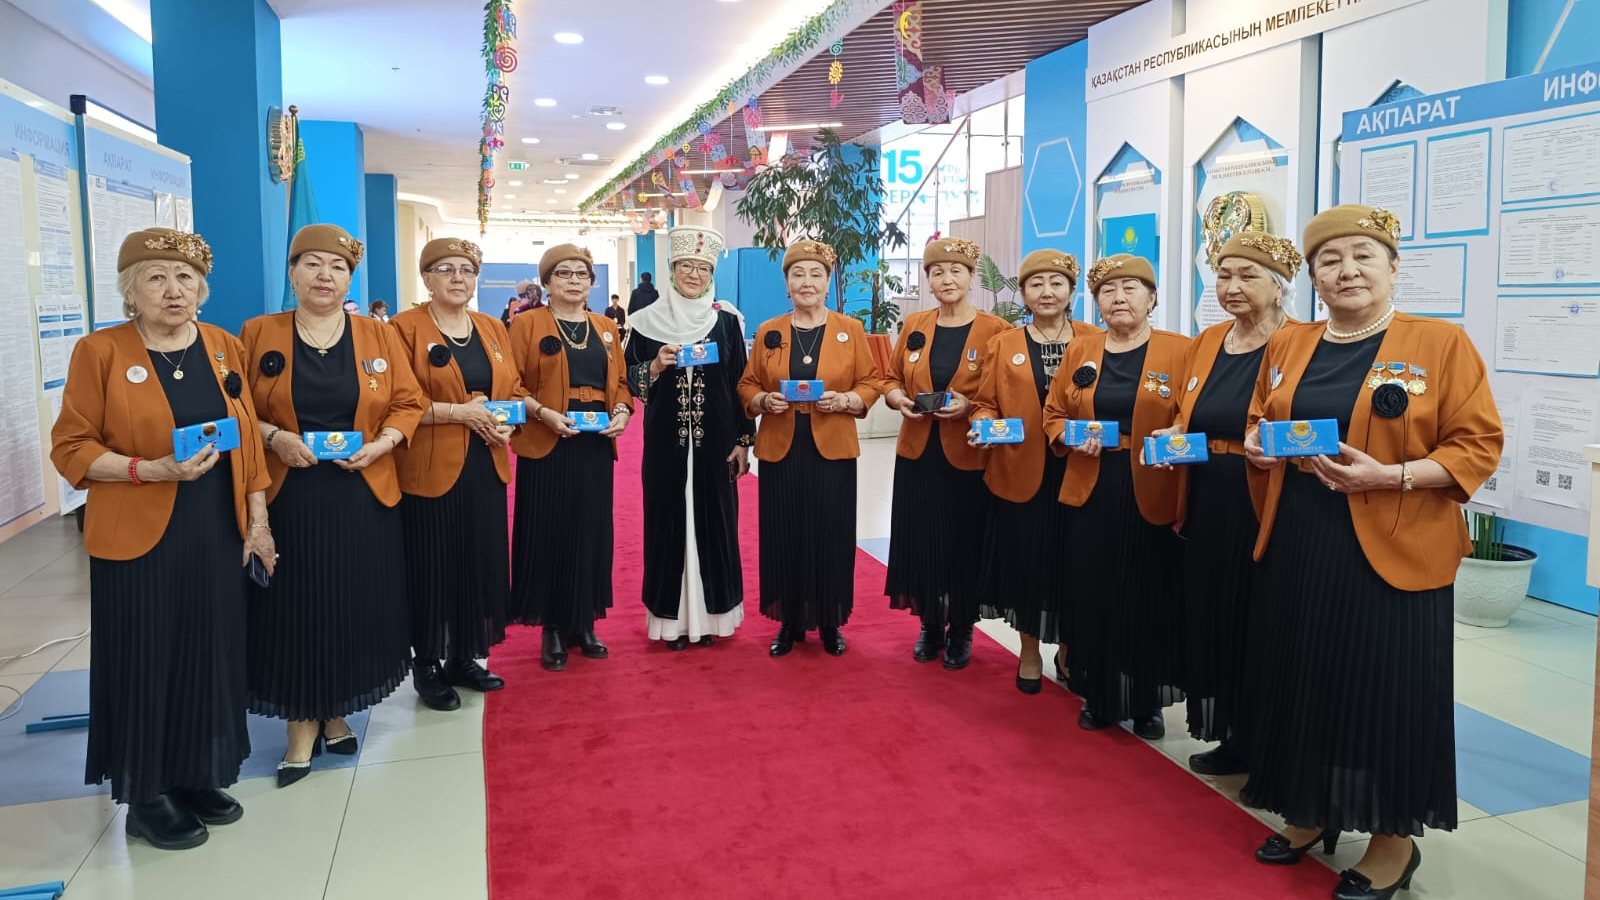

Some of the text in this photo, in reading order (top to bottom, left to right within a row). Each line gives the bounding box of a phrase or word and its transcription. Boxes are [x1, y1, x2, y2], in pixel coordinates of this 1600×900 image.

[1091, 0, 1362, 89] ҚАЗАҚСТАН РЕСПУБЛИКАСЫНЫҢ МЕМЛЕКЕ
[1357, 70, 1600, 134] АҚПАРАТ ИНФ
[14, 123, 70, 157] ИНФОРМАЦИЯ
[882, 149, 923, 184] 15
